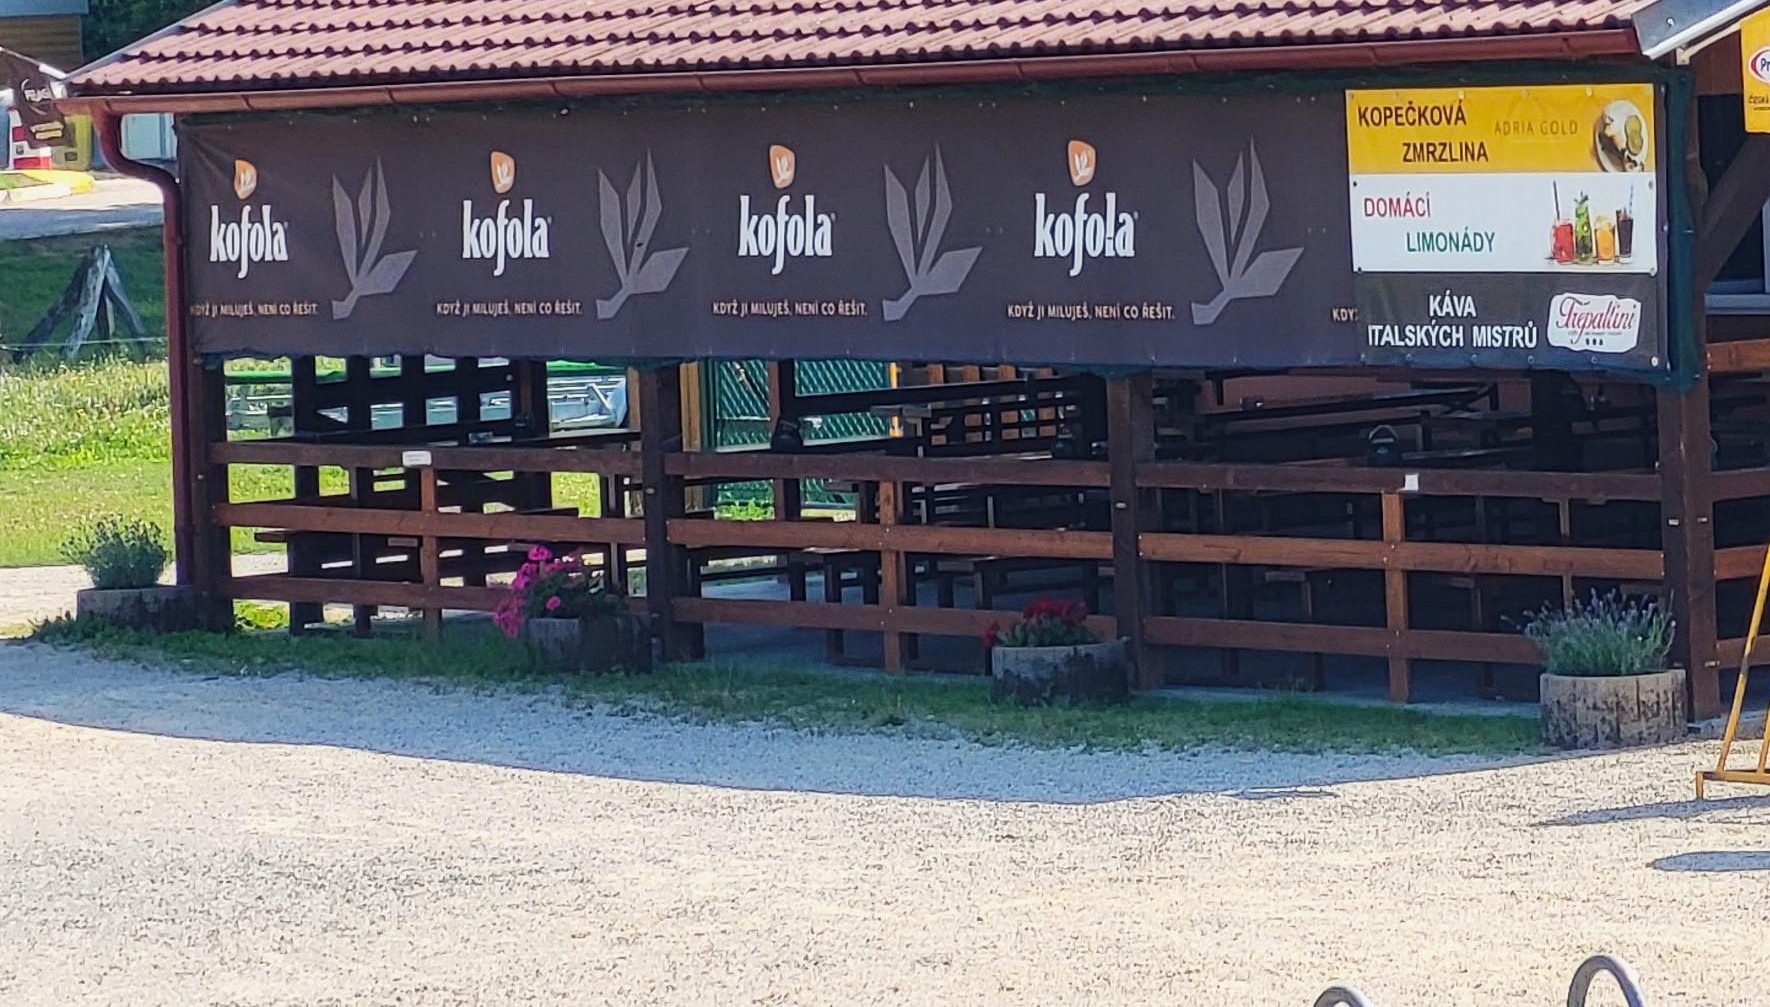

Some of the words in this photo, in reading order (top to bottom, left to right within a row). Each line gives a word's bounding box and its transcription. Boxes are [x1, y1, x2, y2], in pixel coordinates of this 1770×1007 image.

[1358, 100, 1467, 127] KOPEČKOVÁ
[1494, 120, 1533, 135] ADRIA
[1540, 120, 1578, 135] GOLD
[1402, 142, 1489, 163] ZMRZLINA
[1363, 191, 1431, 218] DOMÁCÍ
[209, 204, 289, 279] kofola
[462, 198, 550, 276] kofola
[738, 194, 833, 275] kofola
[1034, 192, 1136, 277] kofola
[1406, 226, 1496, 253] LIMONÁDY
[436, 299, 460, 314] KDYŽ
[463, 303, 470, 317] JI
[514, 299, 536, 314] NENÍ
[539, 303, 552, 314] CO
[712, 299, 738, 314] KDYŽ
[741, 303, 748, 317] JI
[751, 299, 792, 317] MILUJEŠ,
[795, 300, 818, 315] NENÍ
[821, 303, 835, 315] CO
[838, 300, 868, 315] ŘEŠIT.
[1007, 301, 1034, 318] KDYŽ
[1037, 305, 1045, 321] JI
[1047, 302, 1092, 321] MILUJEŠ,
[1095, 302, 1120, 318] NENÍ
[1123, 306, 1139, 318] CO
[1142, 302, 1176, 320] ŘEŠIT.
[1429, 290, 1477, 317] KÁVA
[1368, 319, 1464, 347] ITALSKÝCH
[1472, 321, 1538, 348] MISTRŮ
